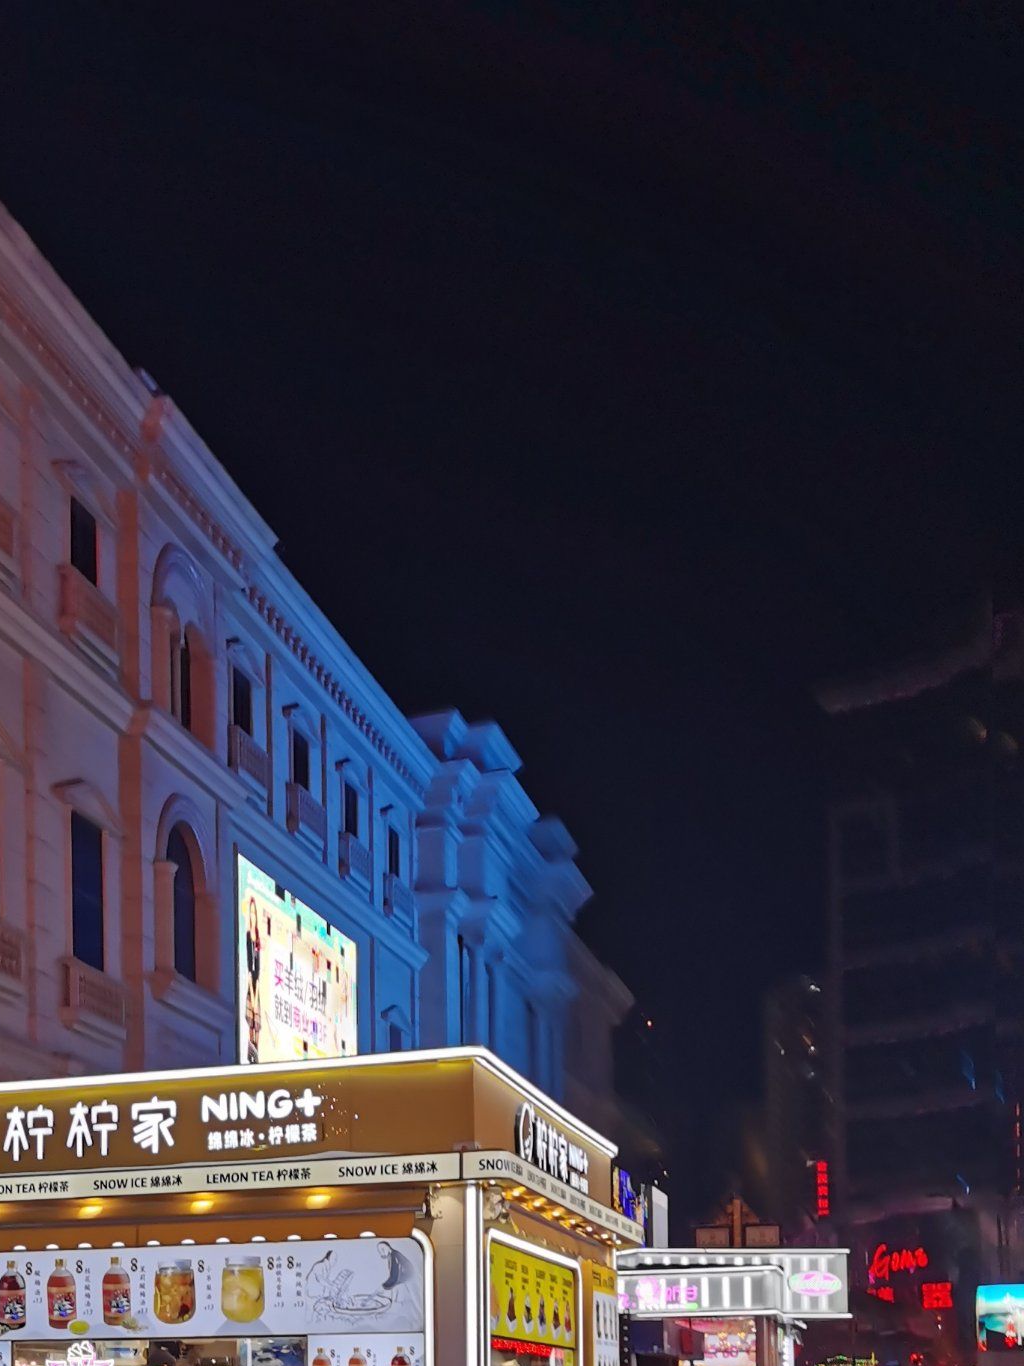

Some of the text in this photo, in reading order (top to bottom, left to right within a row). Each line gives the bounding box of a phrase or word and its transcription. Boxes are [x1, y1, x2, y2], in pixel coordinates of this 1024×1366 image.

[201, 1088, 322, 1123] NING+
[3, 1096, 177, 1161] 柠柠家
[206, 1171, 248, 1184] LEMON
[252, 1170, 274, 1182] TEA
[338, 1164, 376, 1178] SNOW
[380, 1163, 398, 1176] ICE
[16, 1183, 36, 1194] TEA
[93, 1178, 127, 1190] SNOW
[130, 1177, 147, 1188] ICE
